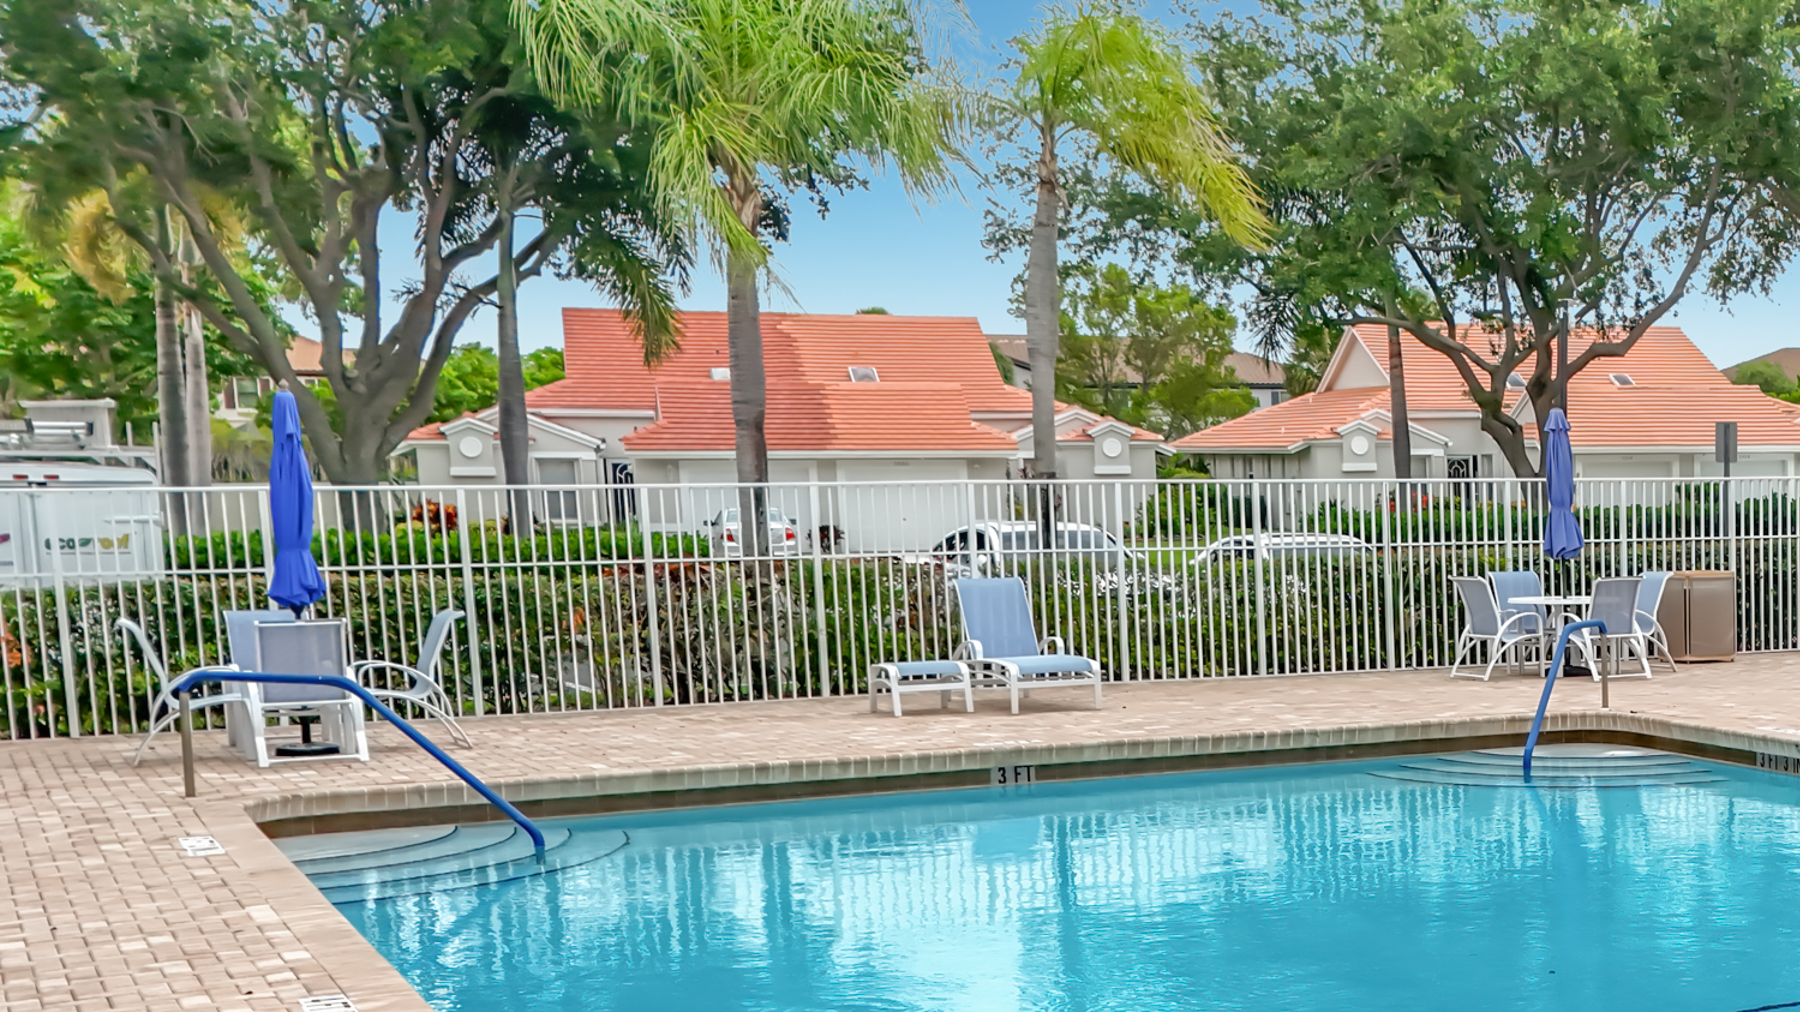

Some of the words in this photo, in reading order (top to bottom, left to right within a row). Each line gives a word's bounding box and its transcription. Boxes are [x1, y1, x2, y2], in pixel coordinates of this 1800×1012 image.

[1760, 752, 1765, 767] 3
[1783, 756, 1789, 771] 3
[998, 766, 1006, 784] 3
[1014, 765, 1034, 783] FT
